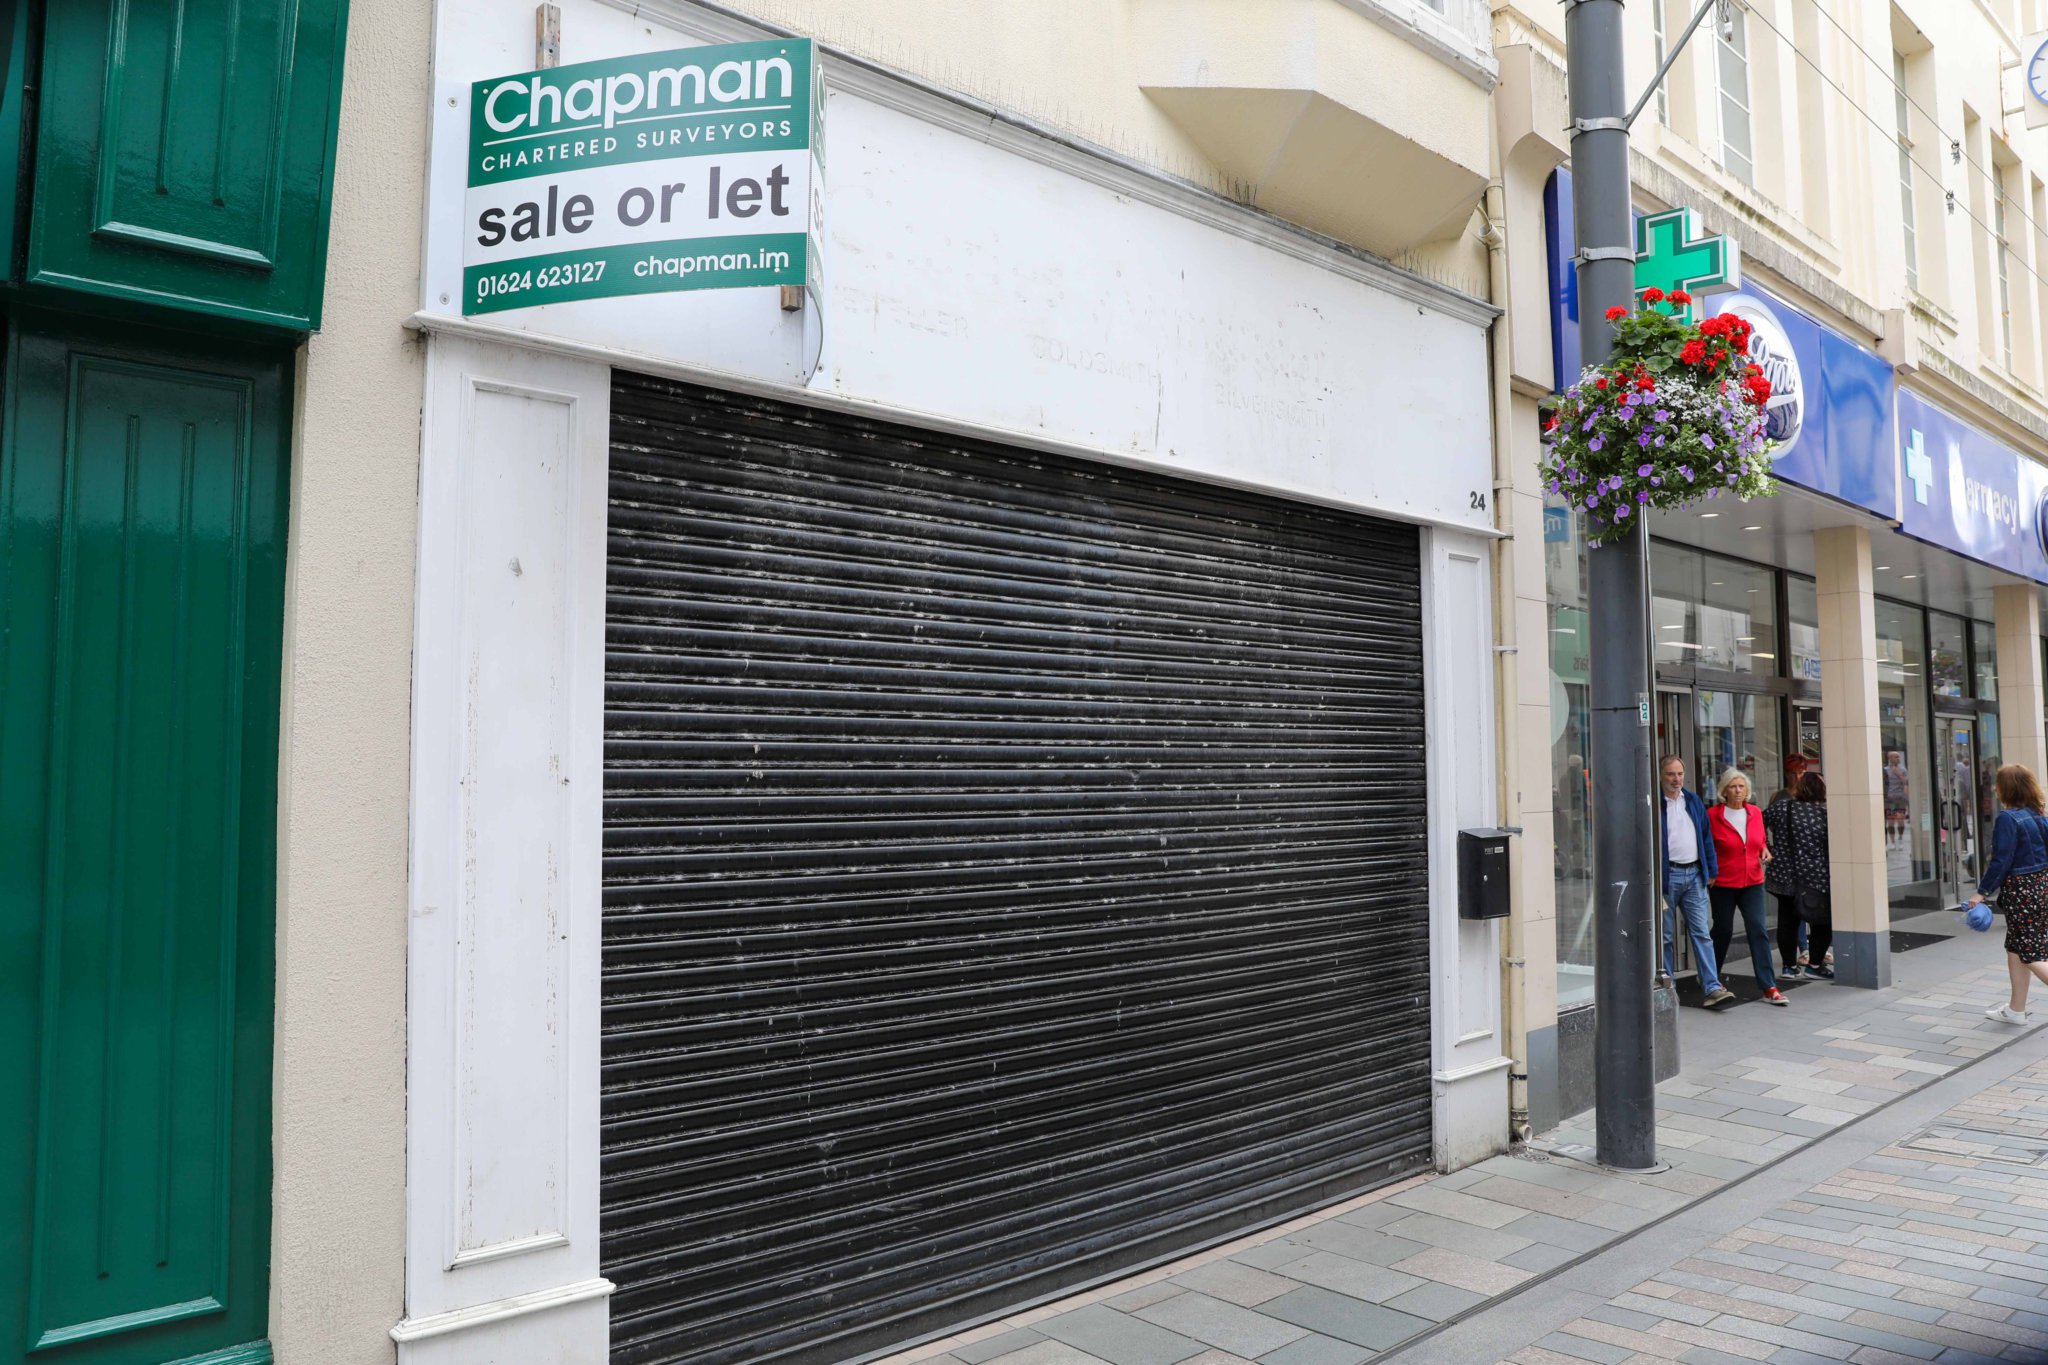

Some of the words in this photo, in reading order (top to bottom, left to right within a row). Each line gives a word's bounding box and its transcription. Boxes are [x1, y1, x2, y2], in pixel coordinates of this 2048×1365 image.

[484, 56, 792, 133] Chapman
[482, 137, 618, 172] CHARTERED
[636, 120, 791, 149] SURVEYORS
[477, 185, 595, 247] sale
[617, 182, 686, 227] or
[708, 164, 790, 219] let
[478, 270, 532, 297] 01624
[536, 261, 607, 288] 623127
[633, 248, 789, 277] chapman.im
[1470, 491, 1486, 511] 24
